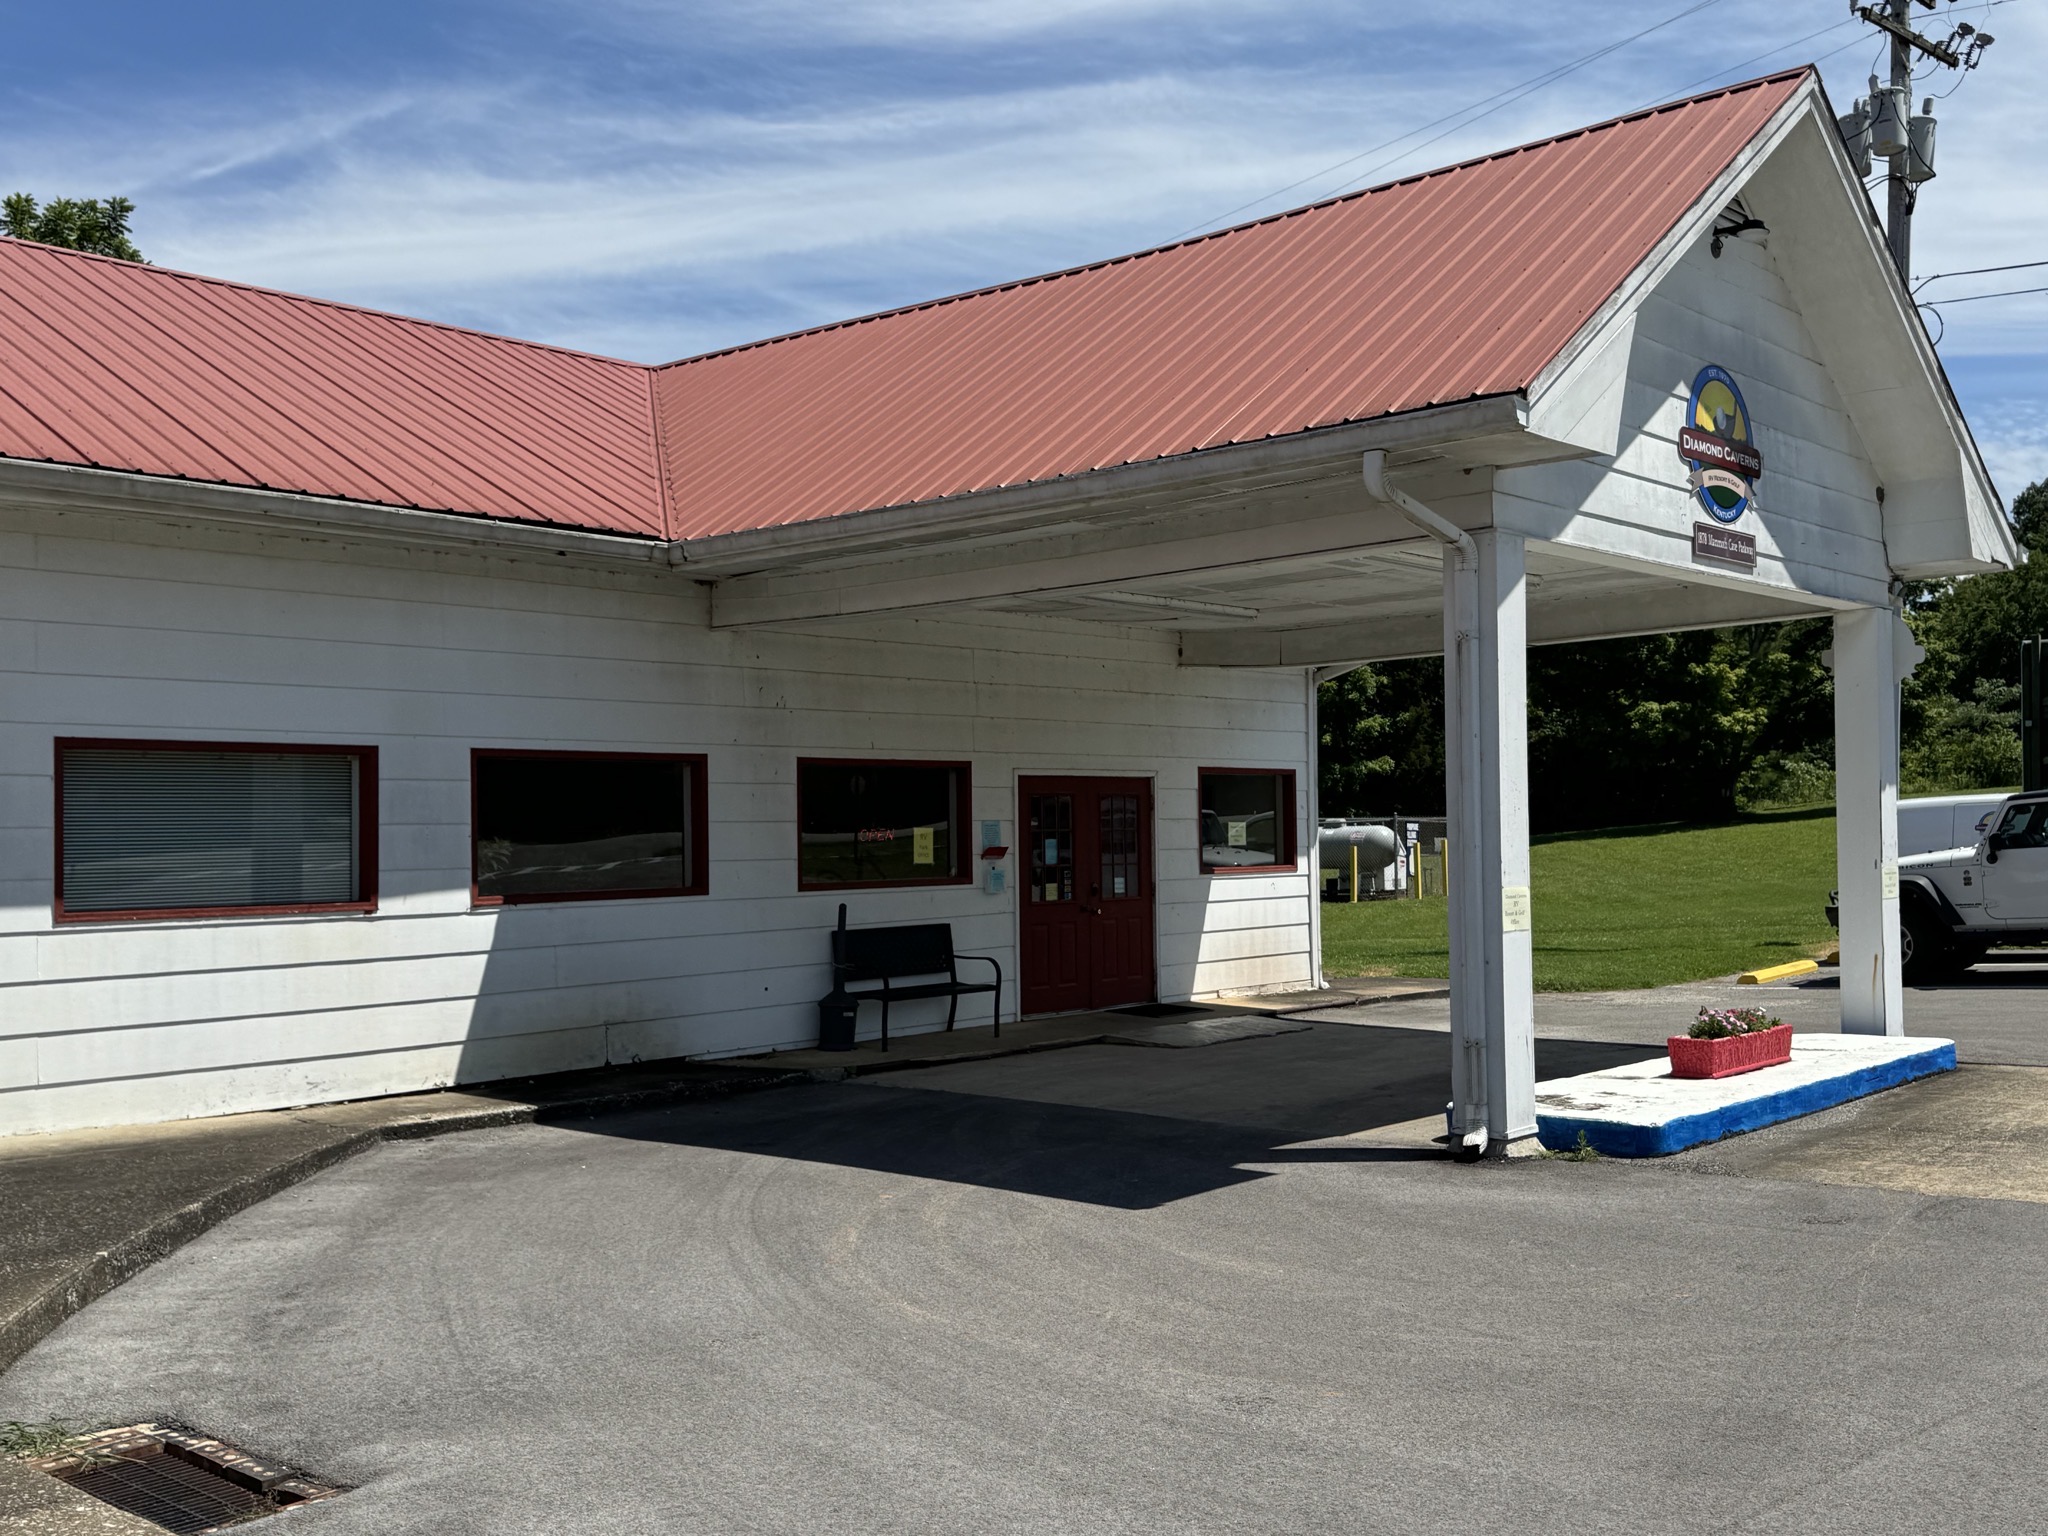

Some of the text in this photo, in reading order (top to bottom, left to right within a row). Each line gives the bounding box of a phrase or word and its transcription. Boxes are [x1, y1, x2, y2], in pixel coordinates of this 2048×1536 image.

[1683, 434, 1759, 470] DIAMOND CAVERNS
[1713, 504, 1736, 519] KENTUCKY
[860, 828, 895, 842] OPEN
